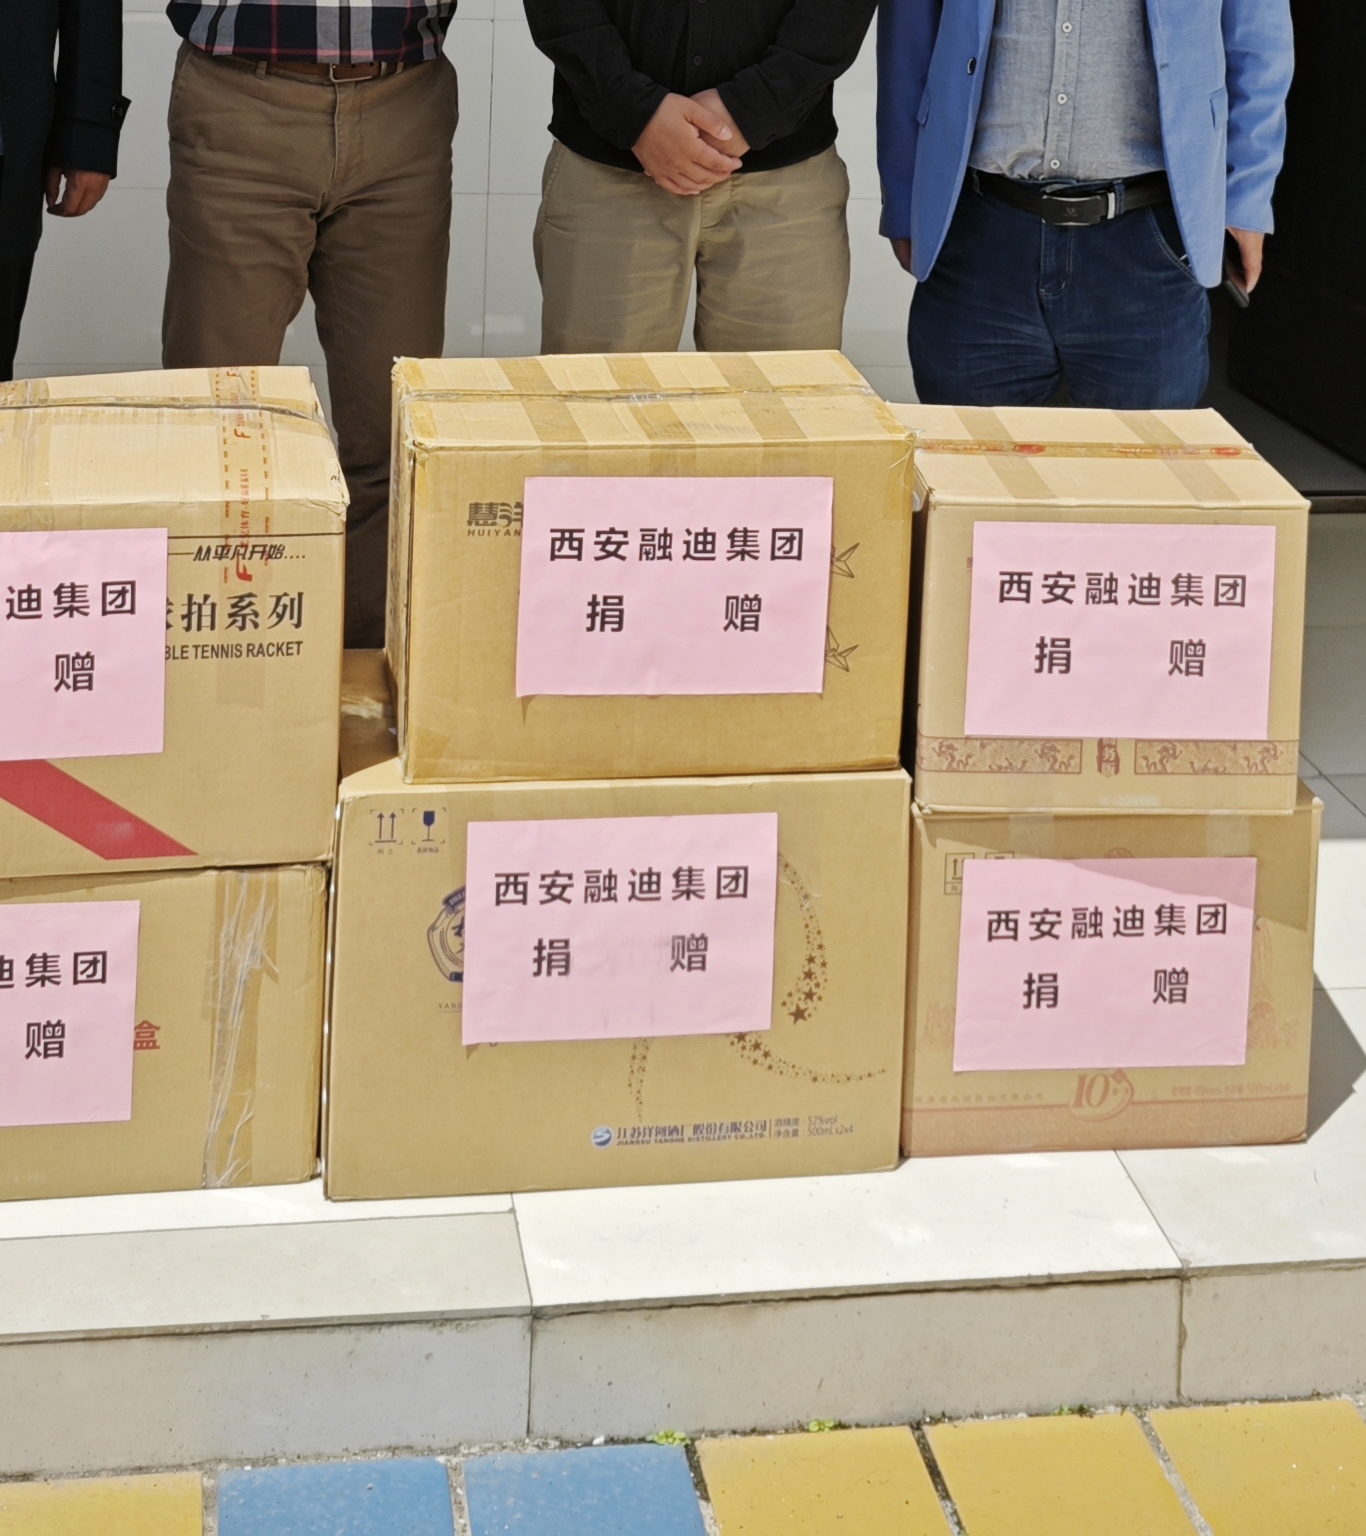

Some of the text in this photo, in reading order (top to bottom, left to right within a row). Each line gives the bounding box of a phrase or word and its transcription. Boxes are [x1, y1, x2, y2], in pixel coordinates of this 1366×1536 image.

[550, 527, 803, 561] 西安融迪集团
[999, 571, 1246, 607] 西安融迪集团
[192, 643, 243, 660] TENNIS
[246, 641, 303, 658] RACKET
[495, 867, 748, 906] 西安融迪集团
[987, 903, 1227, 941] 西安融迪集团
